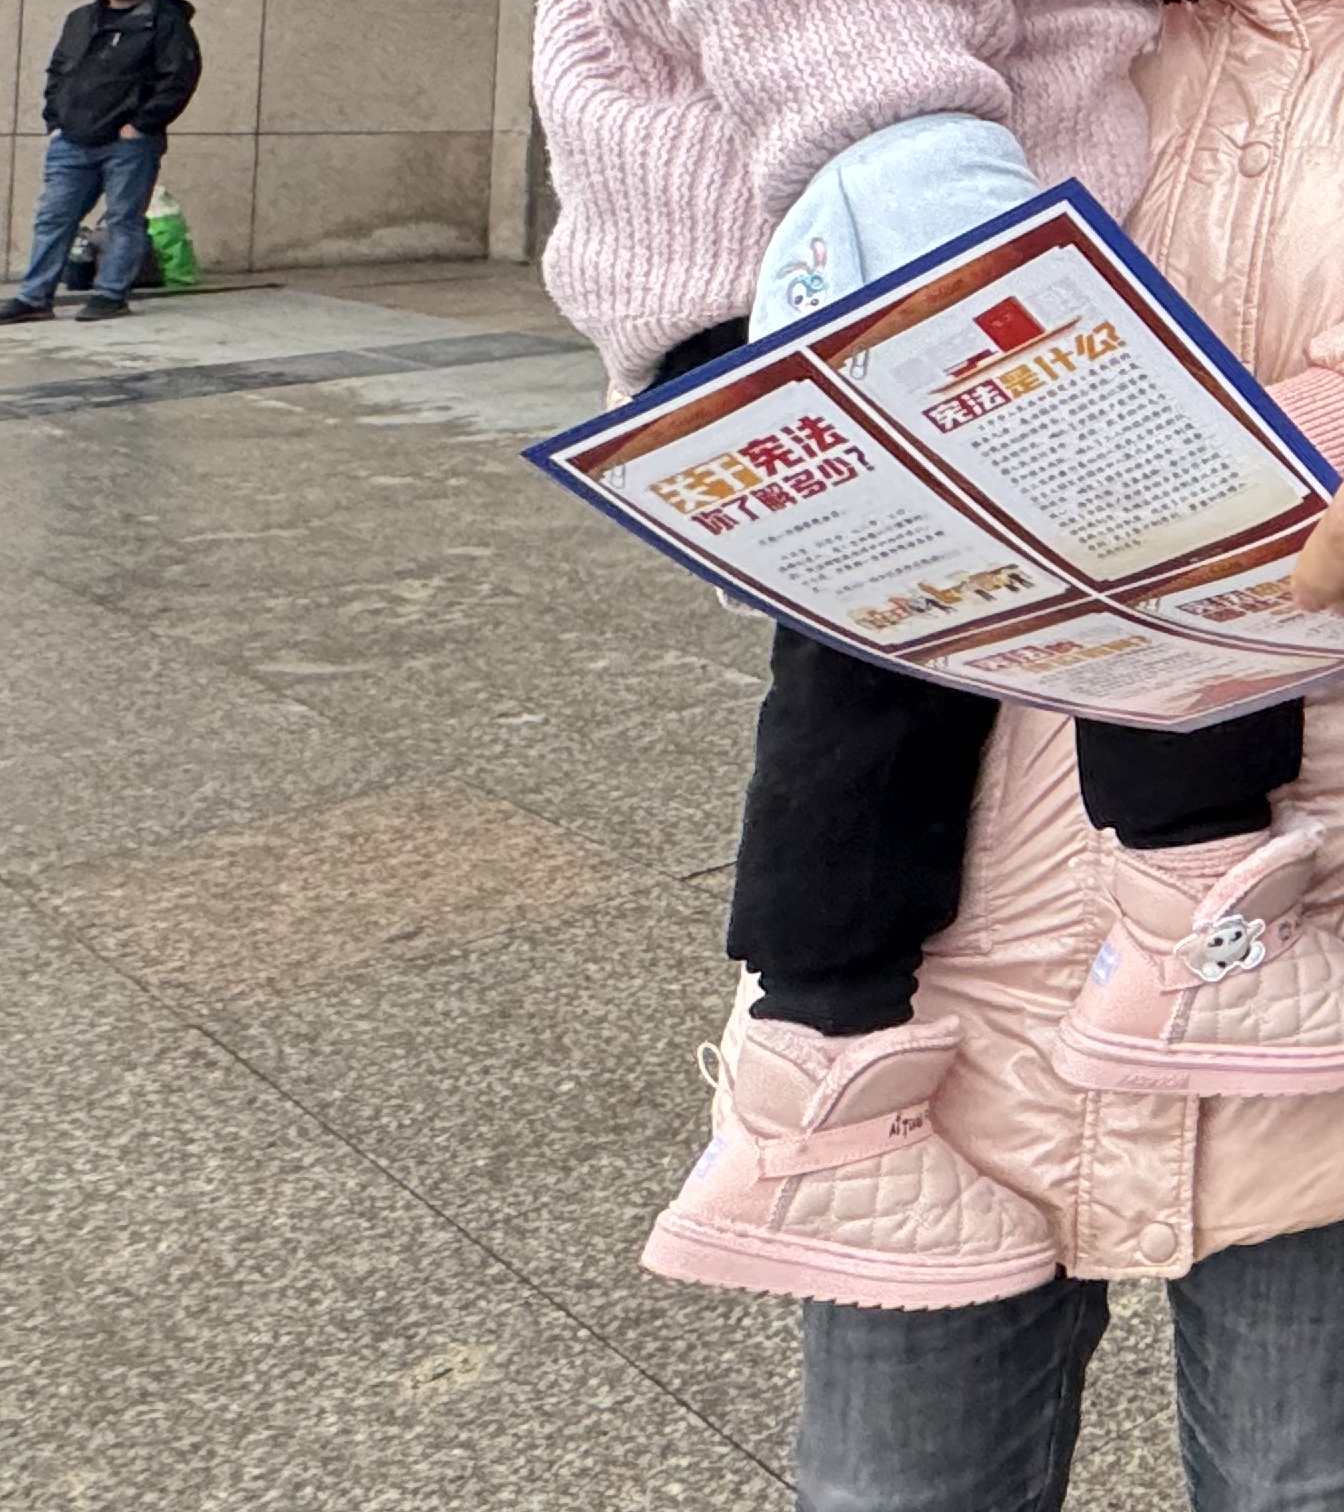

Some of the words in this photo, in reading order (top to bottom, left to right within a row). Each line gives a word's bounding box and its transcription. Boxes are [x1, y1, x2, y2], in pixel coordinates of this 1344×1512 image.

[653, 416, 850, 511] 关于宪法
[690, 445, 875, 536] 你了解多少？
